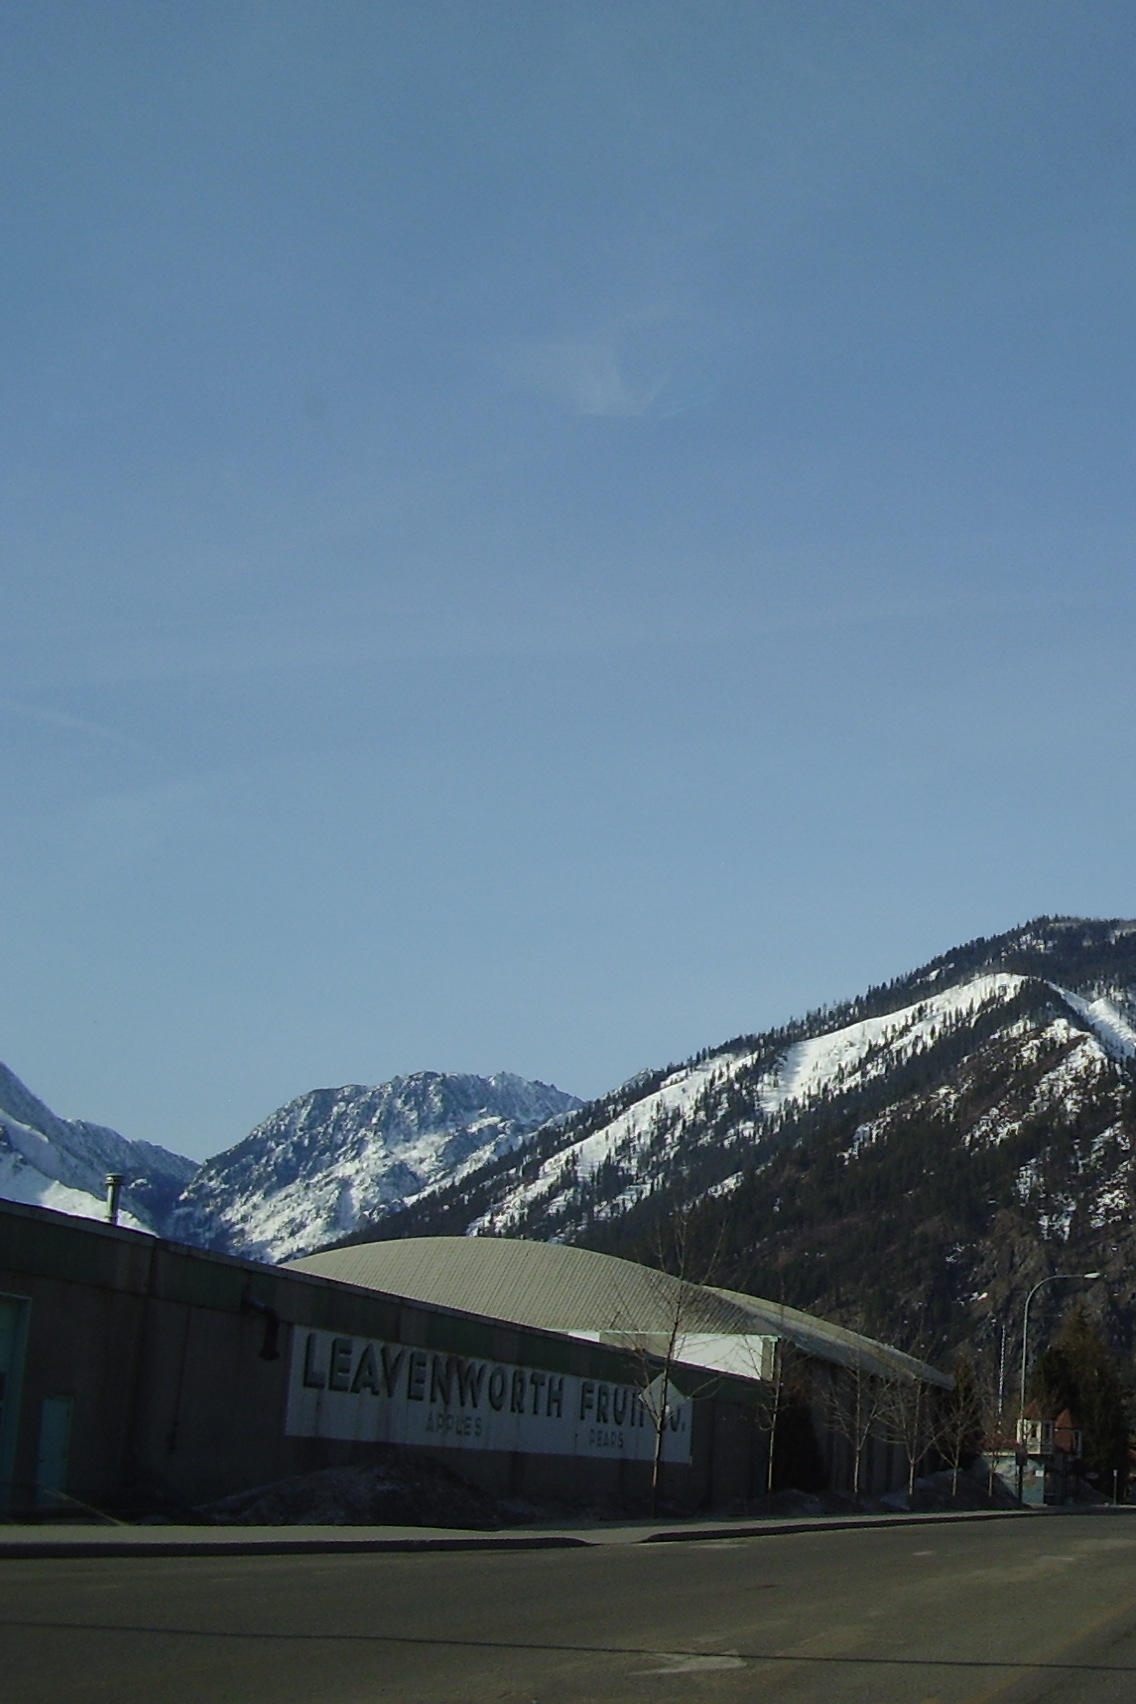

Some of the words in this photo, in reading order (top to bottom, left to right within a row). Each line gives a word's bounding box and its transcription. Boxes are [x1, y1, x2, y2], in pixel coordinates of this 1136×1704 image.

[303, 1332, 564, 1418] LEAVENWORTH
[425, 1411, 482, 1438] APPLES
[588, 1428, 624, 1448] PEARS
